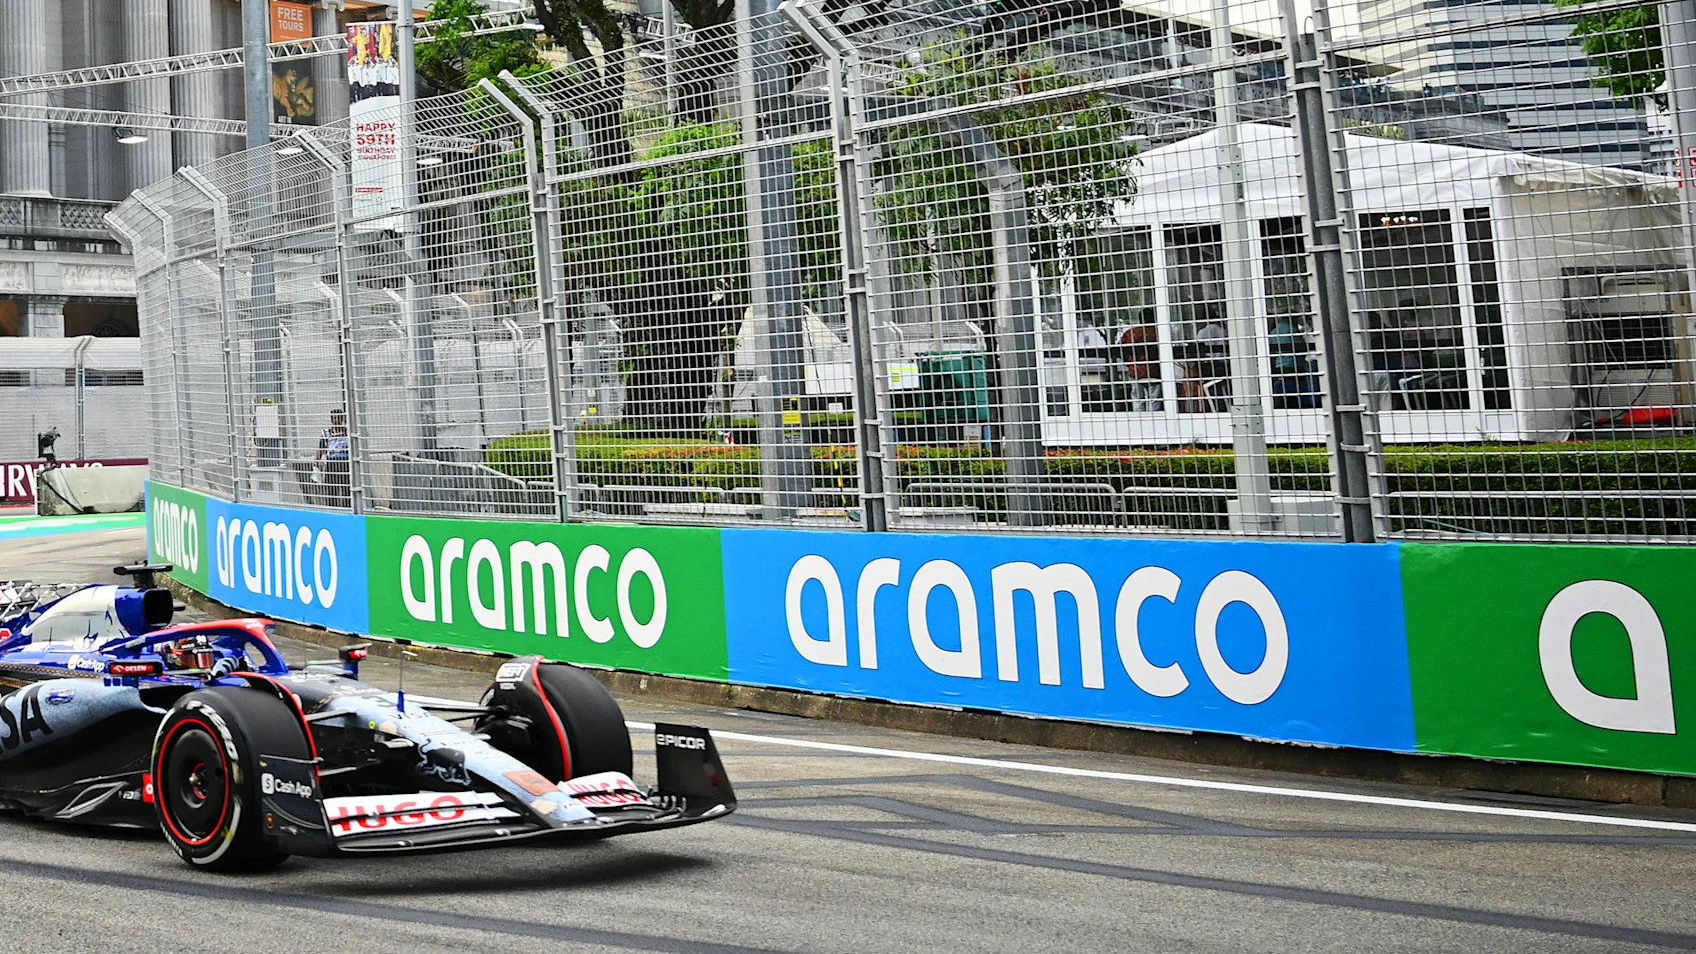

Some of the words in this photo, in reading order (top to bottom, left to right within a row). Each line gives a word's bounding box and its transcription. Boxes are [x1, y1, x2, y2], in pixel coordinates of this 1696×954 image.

[277, 6, 303, 21] FREE
[278, 19, 304, 32] TOURS
[356, 123, 395, 132] HAPPY
[357, 133, 395, 145] 59TH
[153, 496, 199, 574] aramco
[216, 514, 338, 609] aramco
[401, 534, 668, 649] aramco
[785, 554, 1289, 705] aramco
[275, 779, 295, 794] Cash
[295, 781, 312, 798] App
[329, 795, 465, 831] HUGO
